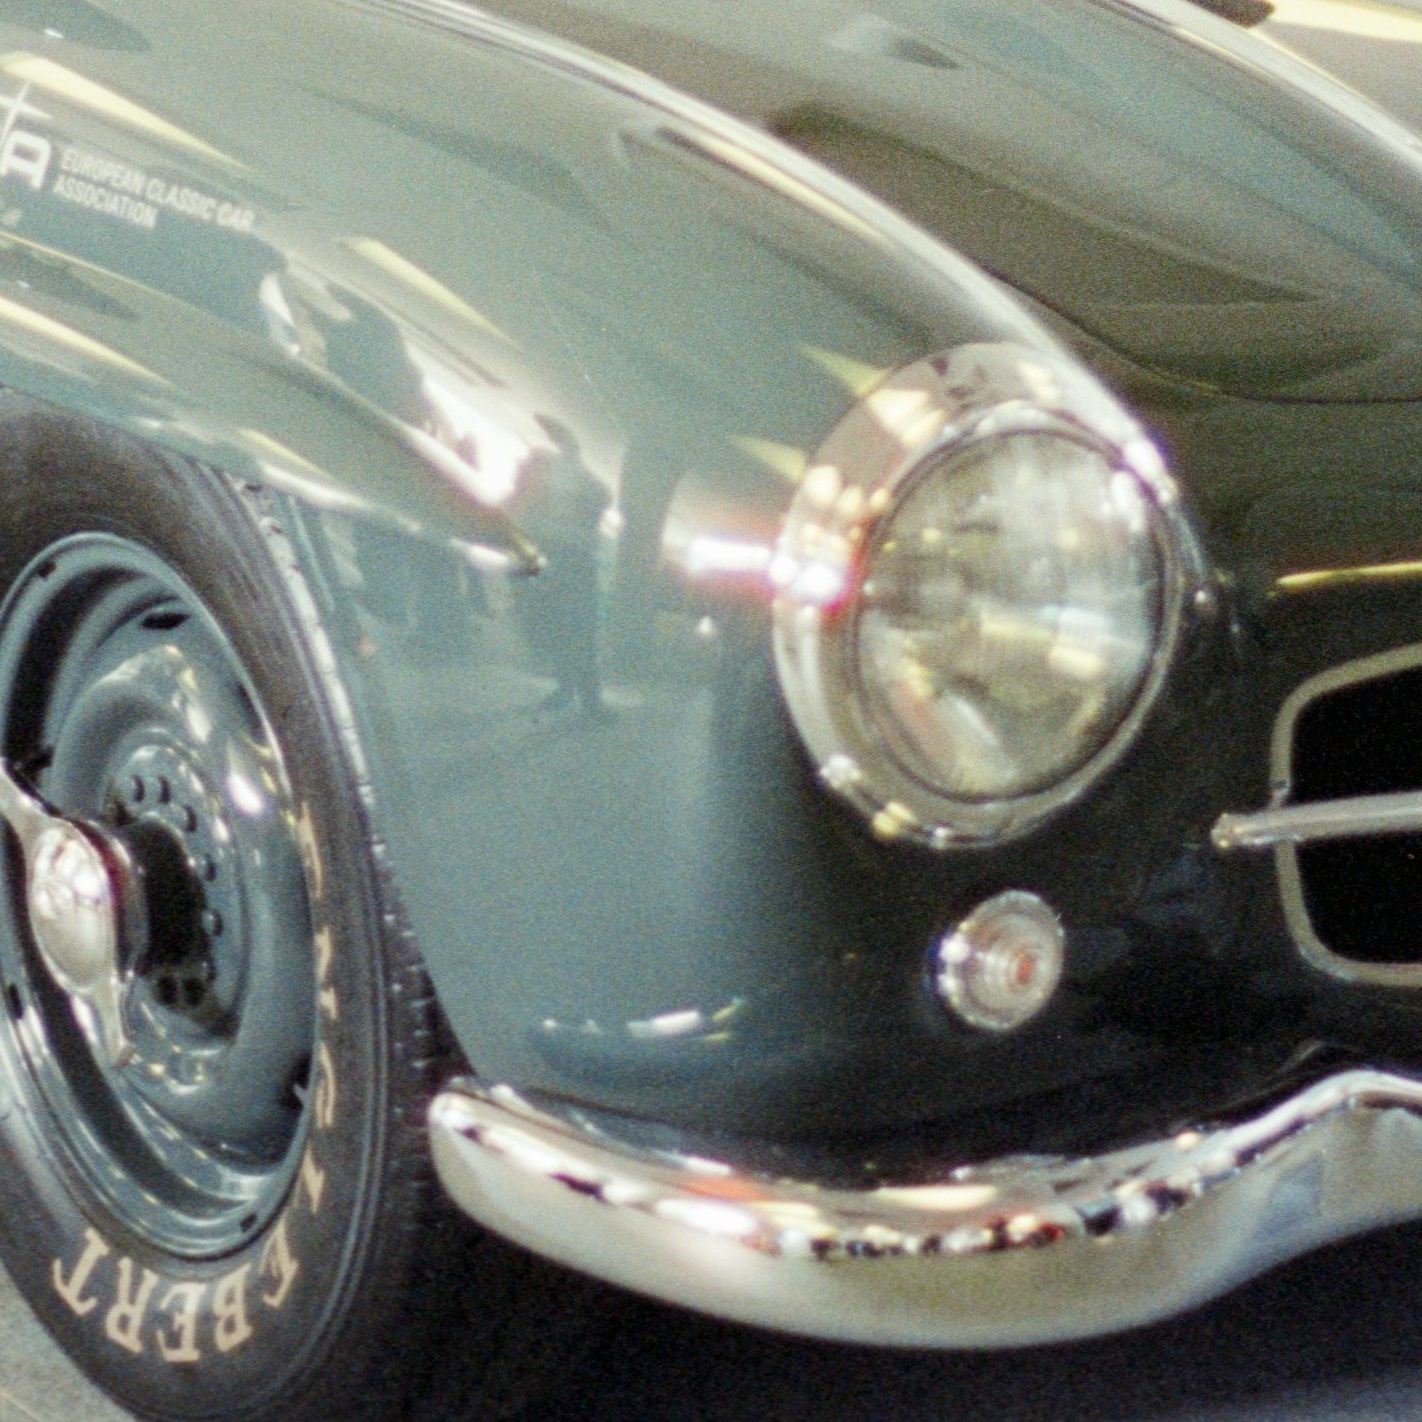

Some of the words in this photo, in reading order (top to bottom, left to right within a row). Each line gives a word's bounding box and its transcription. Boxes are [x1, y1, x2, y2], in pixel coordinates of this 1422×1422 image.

[52, 174, 159, 229] ASSOCIATION
[60, 147, 147, 196] EUROPEAN
[145, 177, 217, 221] CLASSIC
[215, 201, 256, 233] CAR
